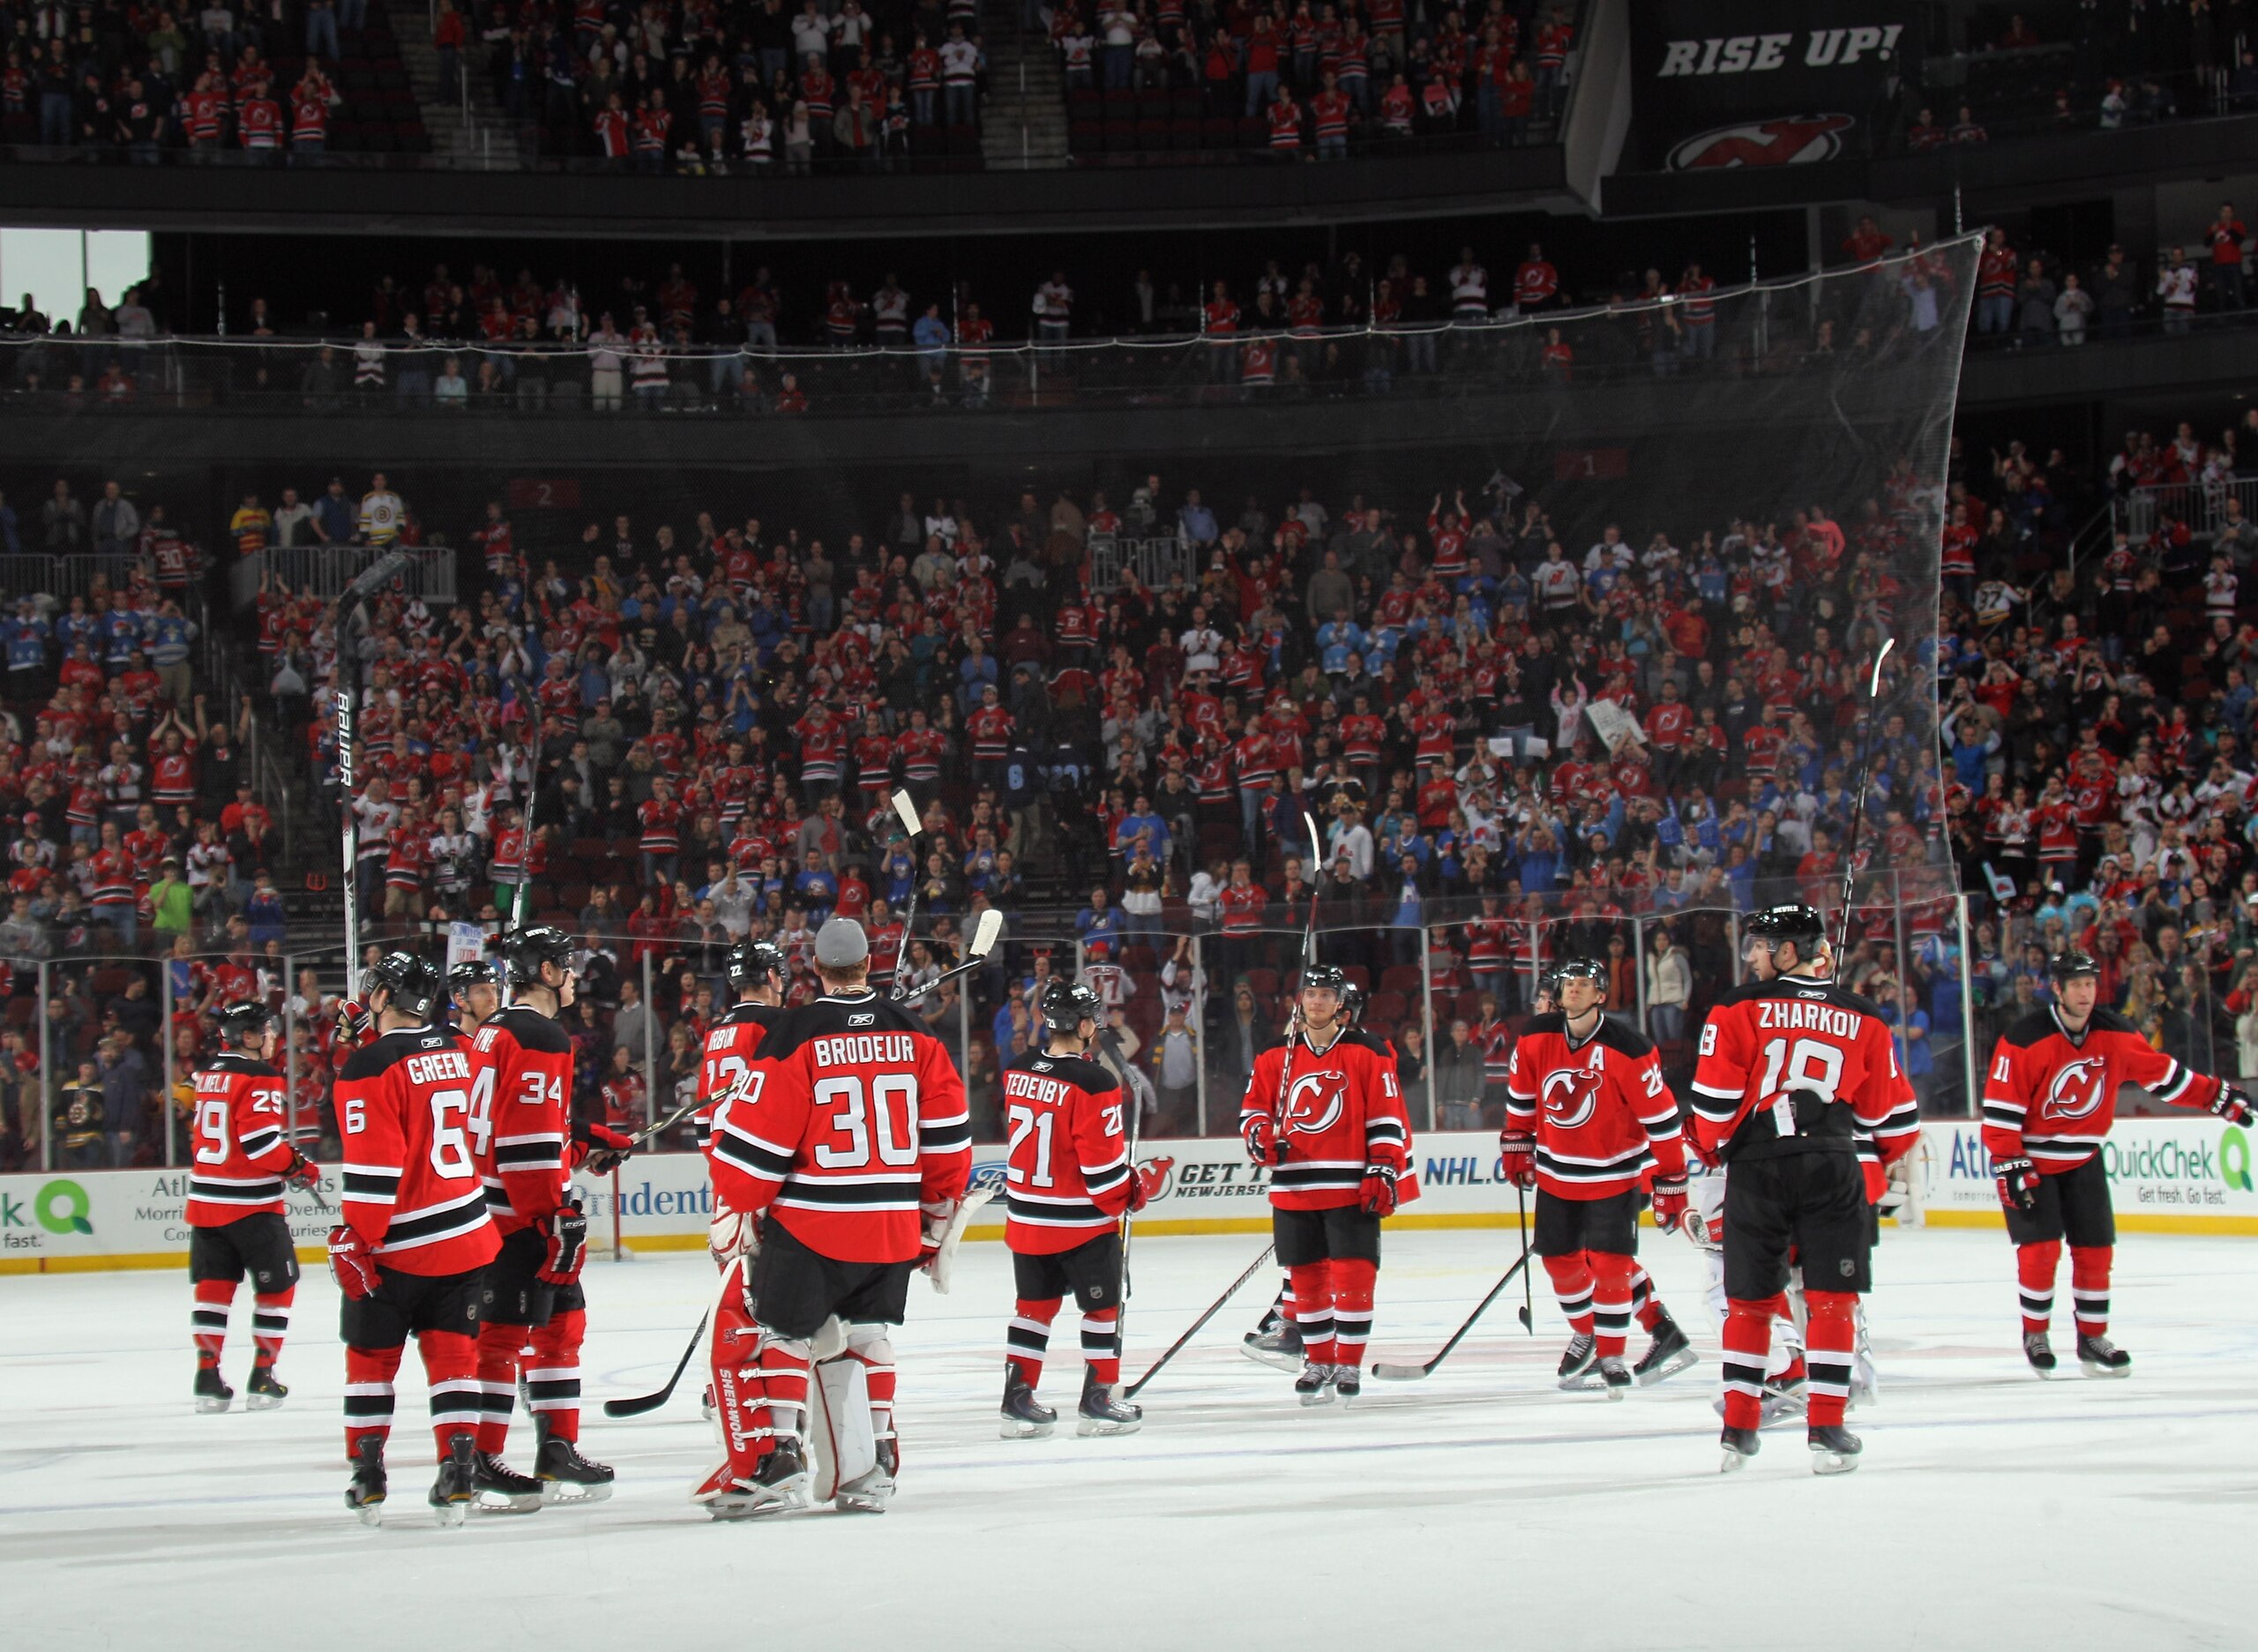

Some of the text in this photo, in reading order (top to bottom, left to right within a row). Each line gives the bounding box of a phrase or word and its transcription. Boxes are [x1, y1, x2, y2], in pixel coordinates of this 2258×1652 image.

[1657, 25, 1903, 77] RISE UP!
[1583, 454, 1595, 475] 1
[537, 483, 552, 505] 2
[155, 549, 183, 569] 30
[526, 928, 550, 938] DEVILS
[730, 965, 743, 976] 22
[908, 977, 940, 999] S19
[1094, 975, 1119, 1000] 17
[416, 998, 429, 1012] 6
[1758, 1002, 1862, 1041] ZHARKOV
[473, 1028, 498, 1052] YNE
[813, 1035, 915, 1067] BRODEUR
[407, 1052, 470, 1085] GREENE
[1509, 1048, 1518, 1075] 6
[1589, 1046, 1605, 1071] A
[1760, 1038, 1843, 1103] 18
[1889, 1047, 1897, 1079] 1
[1993, 1056, 2010, 1083] 11
[195, 1073, 229, 1094] LMELA
[519, 1071, 562, 1109] 34
[1006, 1073, 1070, 1107] TEDENBY
[1641, 1063, 1664, 1099] 26
[251, 1089, 281, 1115] 29
[2210, 1080, 2230, 1114] EAST
[345, 1099, 365, 1134] 6
[813, 1073, 918, 1169] 30
[1100, 1104, 1124, 1138] 21
[430, 1089, 475, 1179] 6
[1007, 1104, 1053, 1188] 21
[1179, 1162, 1243, 1185] GET
[1424, 1156, 1510, 1185] NHL.C
[1994, 1160, 2032, 1174] EASTO
[2103, 1139, 2216, 1185] QuickChek
[971, 1168, 1006, 1197] Fo
[1175, 1185, 1267, 1199] NEWJERSE
[2138, 1186, 2226, 1205] Get fresh. Go fast.
[571, 1181, 713, 1217] Prudent
[134, 1206, 183, 1221] Morri
[4, 1233, 42, 1249] fast.
[290, 1224, 330, 1238] uries
[329, 1243, 355, 1254] UER
